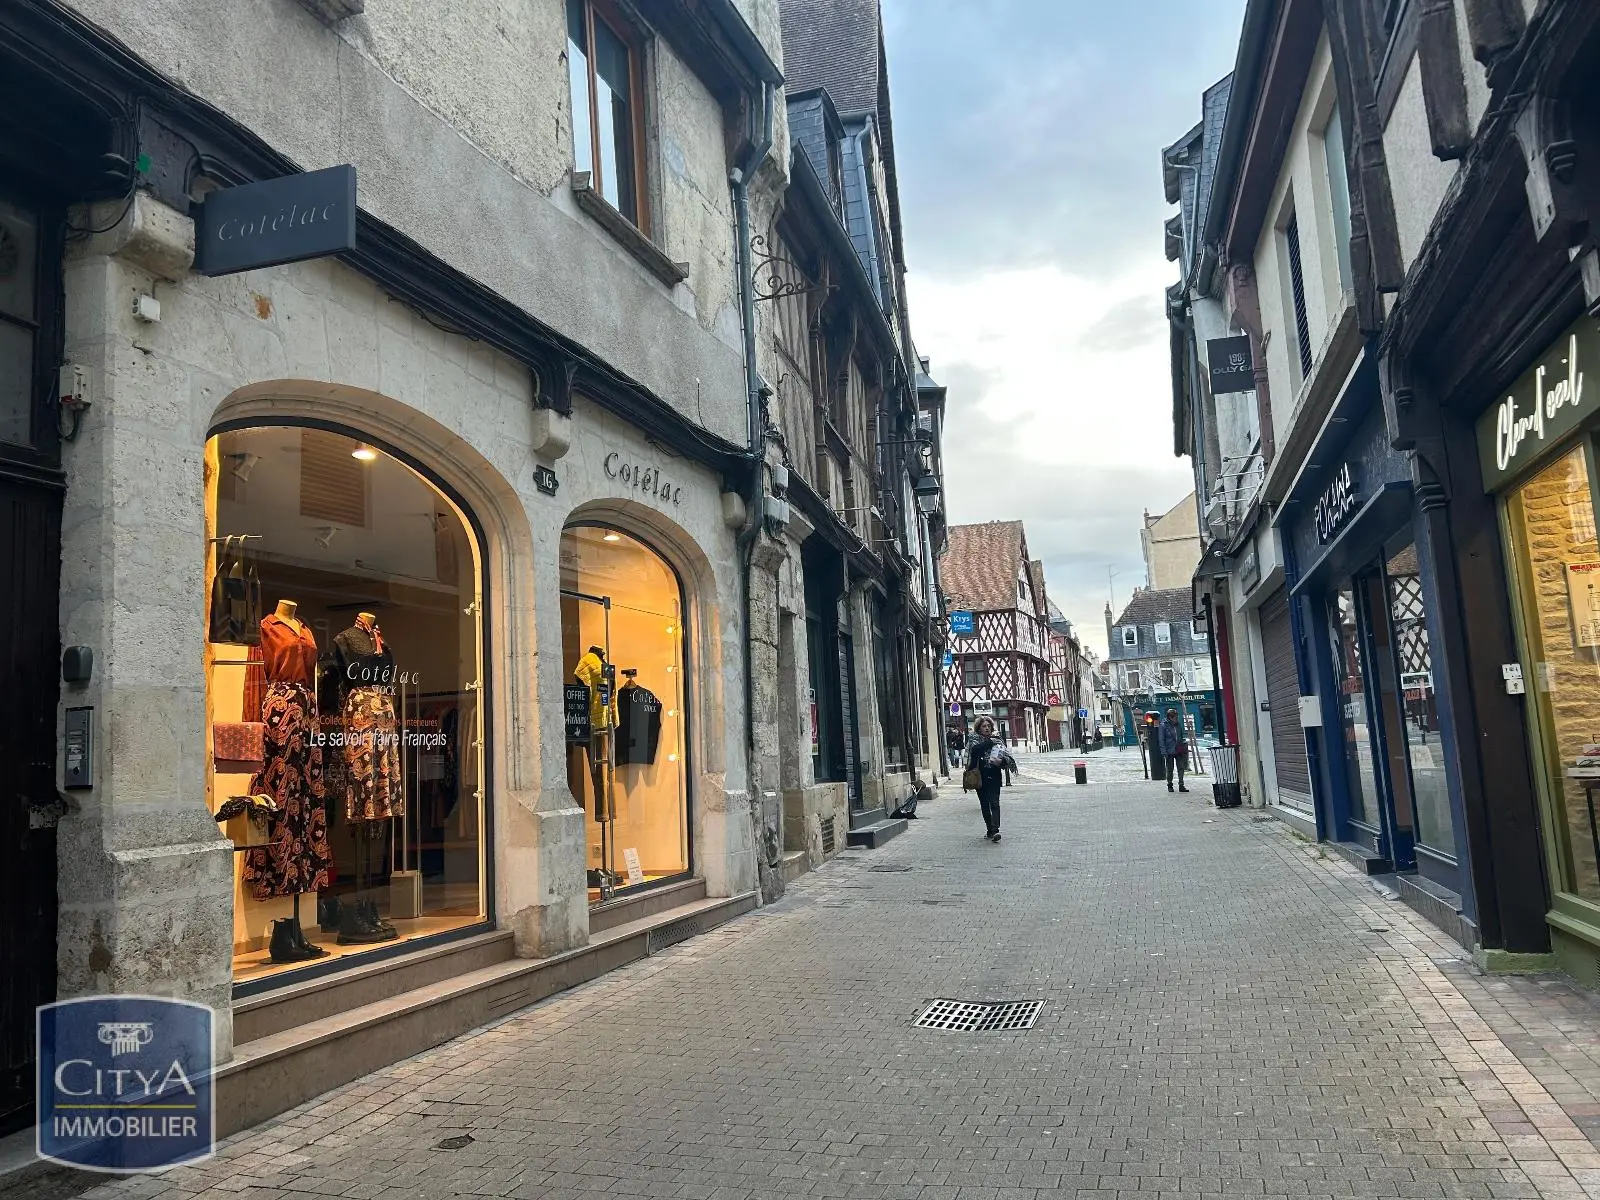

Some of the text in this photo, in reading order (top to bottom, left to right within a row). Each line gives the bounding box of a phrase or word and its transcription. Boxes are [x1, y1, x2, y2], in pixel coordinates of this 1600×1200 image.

[218, 203, 335, 241] Cotélac
[541, 471, 553, 489] 16
[604, 452, 681, 505] Cotélac
[953, 615, 970, 623] Krys
[346, 661, 419, 685] Cotélac
[566, 690, 586, 700] OFFRE
[1165, 694, 1206, 702] IMMBILIER
[310, 728, 325, 747] Le
[402, 728, 447, 751] Français
